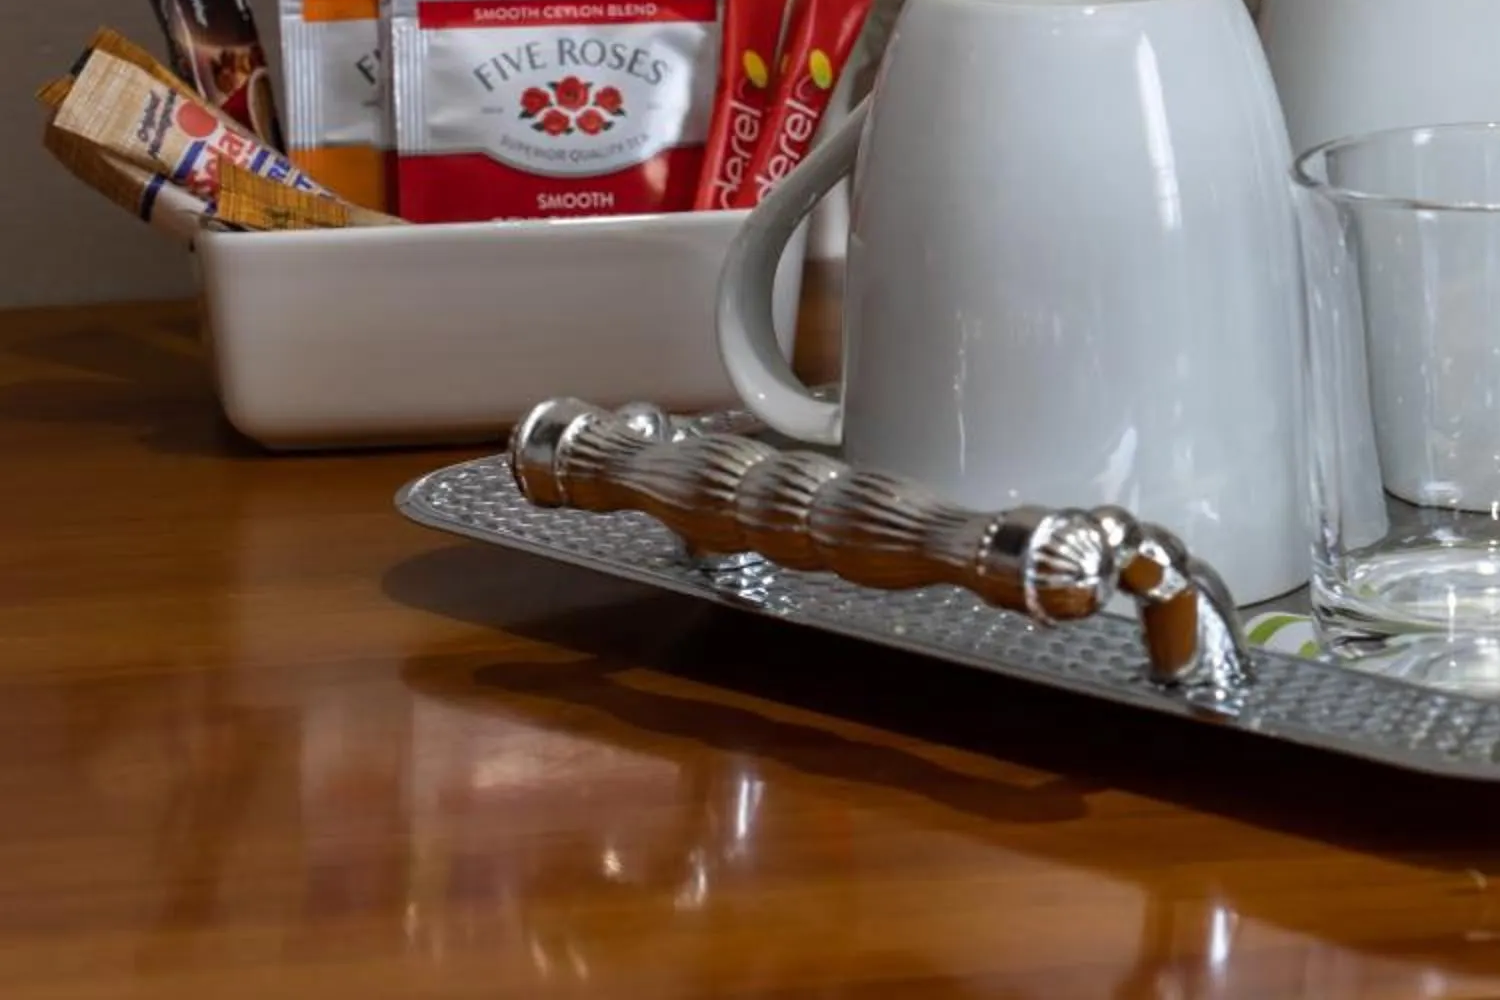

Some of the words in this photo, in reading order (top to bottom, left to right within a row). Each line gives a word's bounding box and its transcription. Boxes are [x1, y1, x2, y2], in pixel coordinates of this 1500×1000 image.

[473, 7, 539, 21] SMOOTH
[543, 5, 604, 19] CEYLON
[607, 3, 657, 18] BLEND
[473, 41, 548, 93] FIVE
[556, 37, 669, 86] ROSES
[536, 191, 615, 210] SMOOTH
